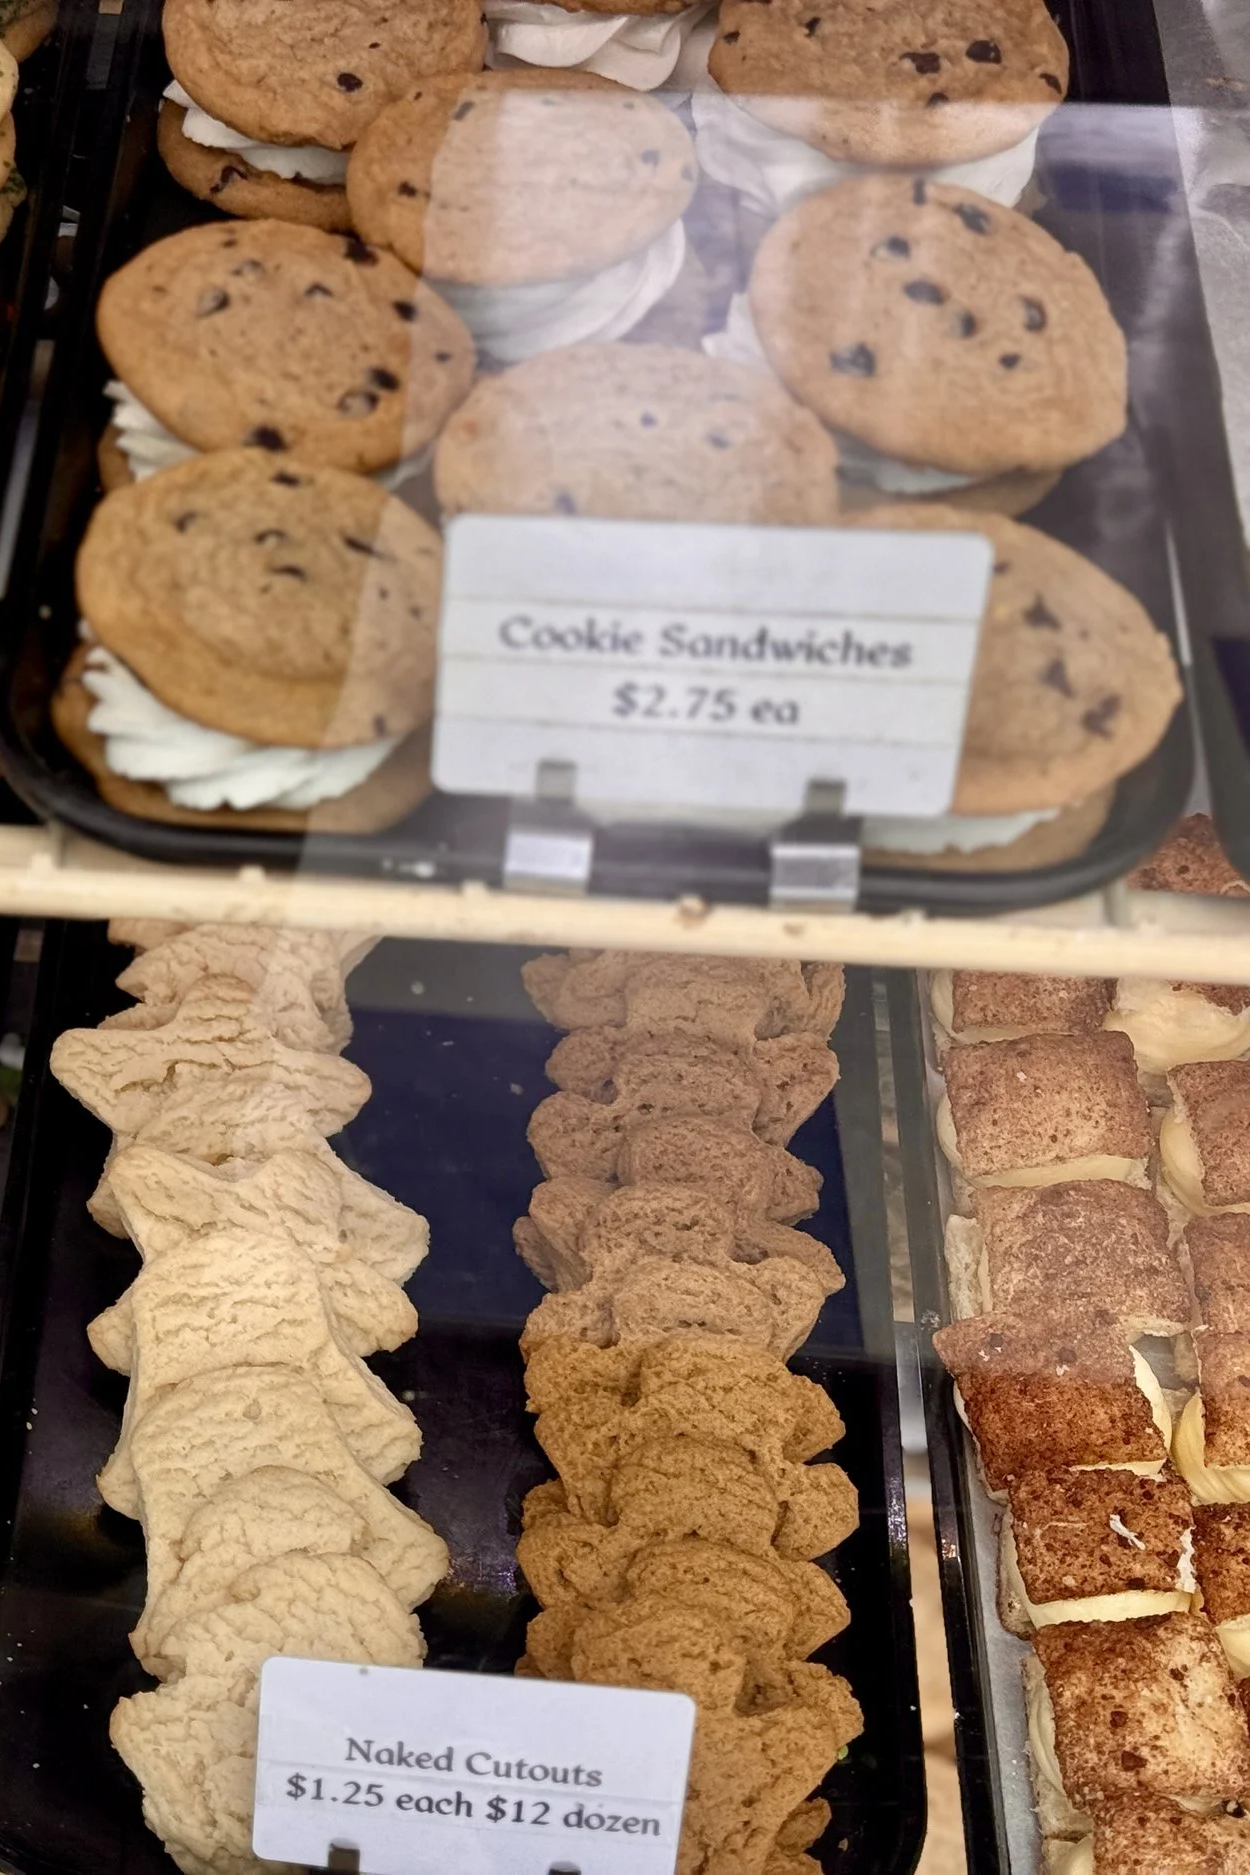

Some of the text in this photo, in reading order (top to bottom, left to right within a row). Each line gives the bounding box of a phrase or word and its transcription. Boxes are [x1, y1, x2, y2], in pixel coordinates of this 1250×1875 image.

[498, 614, 913, 669] Cookie Sandwiches
[611, 682, 801, 726] $2.75 ea
[345, 1738, 603, 1788] Naked Cutouts
[286, 1773, 661, 1836] $1.25 each $12 dozen
